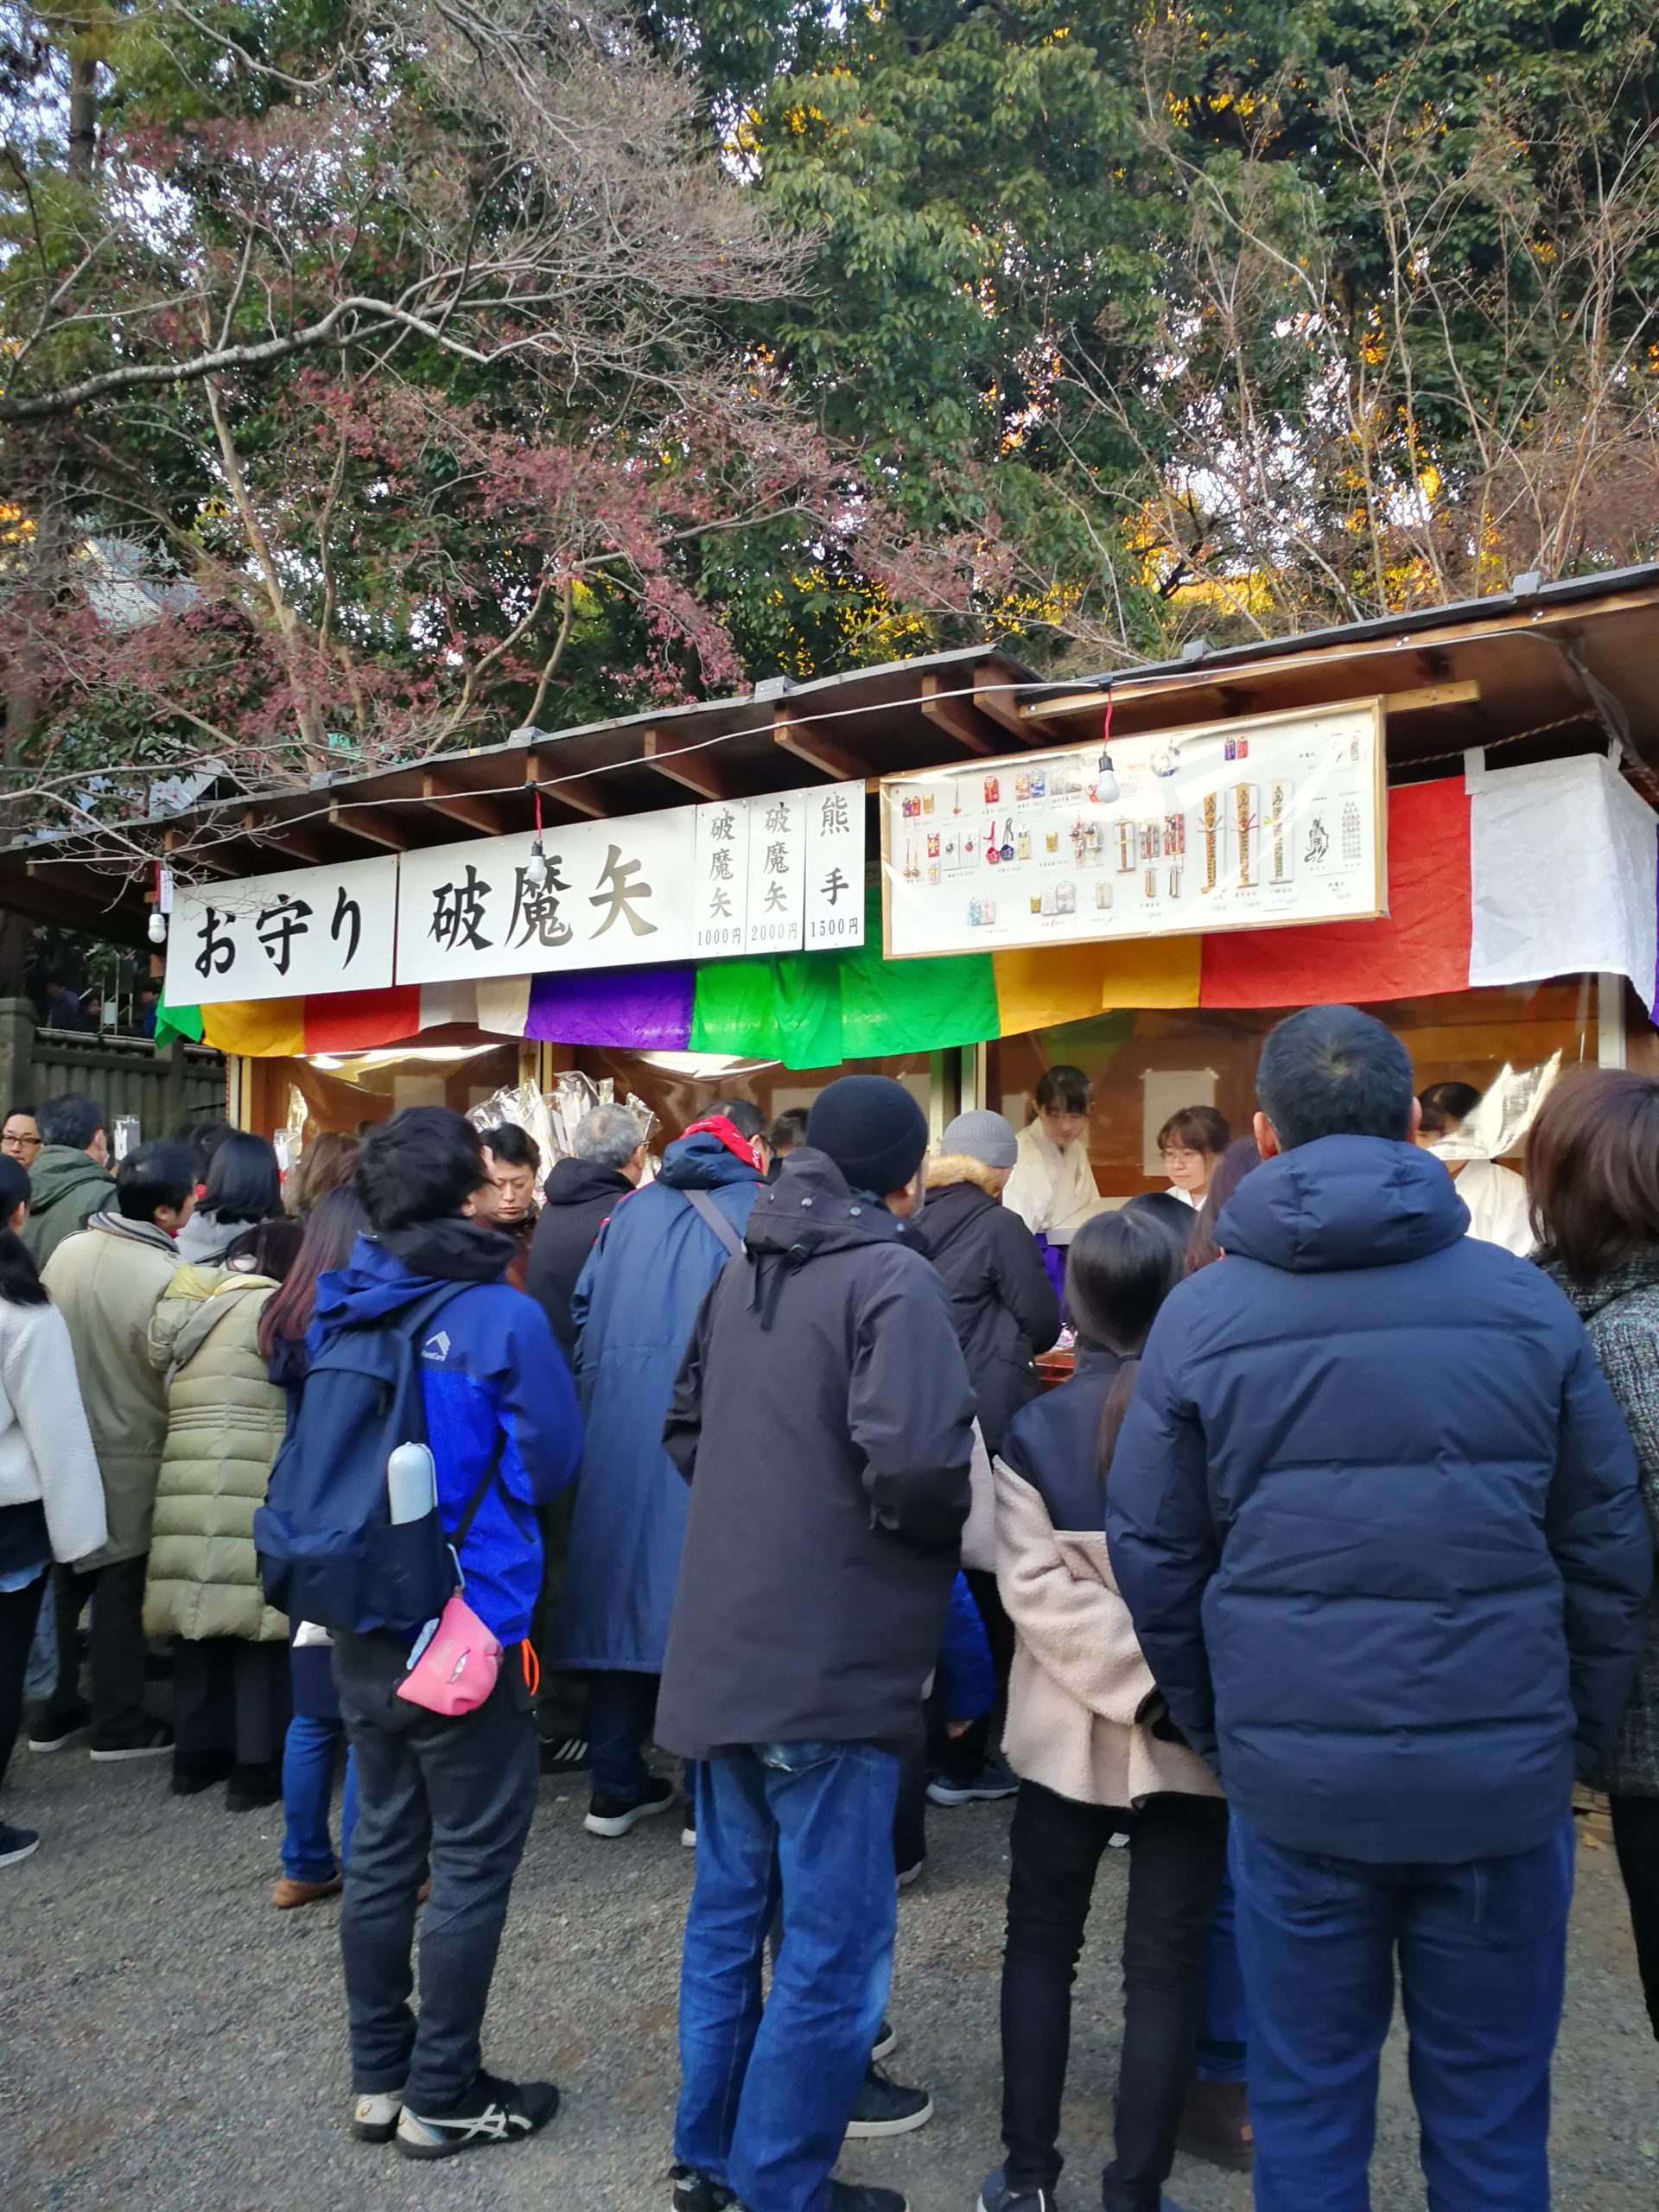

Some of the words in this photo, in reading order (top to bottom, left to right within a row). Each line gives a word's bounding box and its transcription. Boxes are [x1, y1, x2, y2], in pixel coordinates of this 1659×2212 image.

[427, 843, 659, 952] 破魔矢
[709, 810, 736, 918] 破魔矢
[763, 806, 792, 913] 破魔矢
[820, 795, 850, 906] 熊手
[194, 886, 362, 978] お守り
[697, 927, 741, 946] 1000円
[751, 922, 798, 941] 2000円
[810, 917, 858, 938] 1500円
